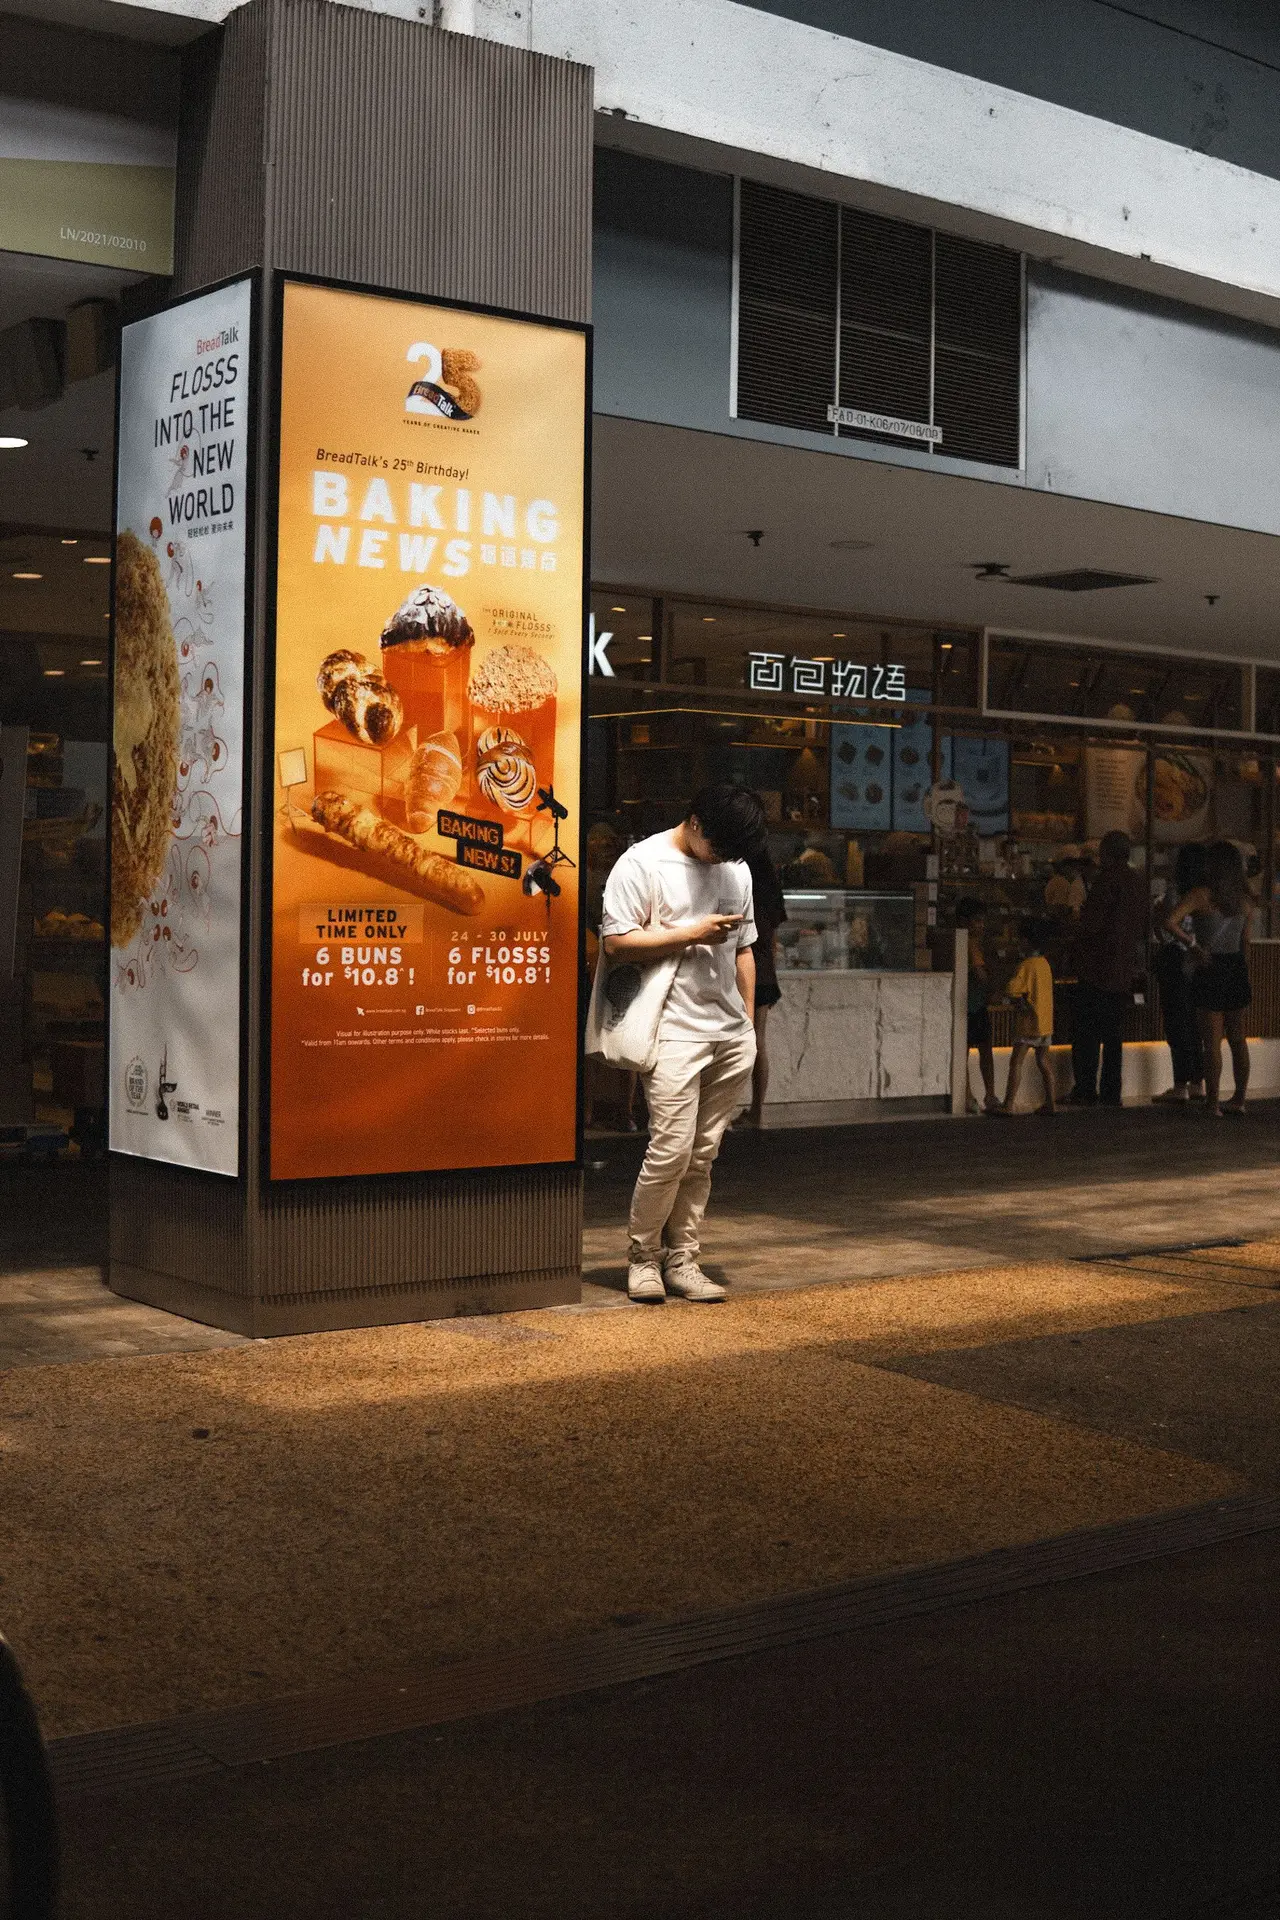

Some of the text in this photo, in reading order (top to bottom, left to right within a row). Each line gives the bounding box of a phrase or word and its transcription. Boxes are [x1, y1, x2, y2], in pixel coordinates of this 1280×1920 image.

[60, 227, 147, 251] LN/2021/02010
[197, 326, 239, 355] BreadTalk
[170, 354, 239, 403] FLOSSS
[155, 397, 236, 448] INTO THE
[402, 419, 421, 427] YEARS
[433, 423, 460, 433] CREATIVE
[193, 438, 235, 479] NEW
[316, 448, 470, 481] BreadTalk's 25th Birthday!
[169, 483, 235, 525] WORLD
[312, 469, 561, 544] BAKING
[313, 523, 473, 578] NEWS
[492, 608, 538, 621] ORIGINAL
[516, 620, 552, 632] FLOSSS
[440, 816, 499, 845] BAKING
[463, 846, 516, 874] NEWS!
[327, 909, 398, 923] LIMITED
[316, 925, 408, 938] TIME ONLY
[451, 931, 469, 942] 24
[489, 931, 507, 942] 30
[513, 931, 549, 942] JULY
[316, 946, 403, 965] 6 BUNS
[448, 946, 551, 965] 6 FLOSSS
[302, 967, 334, 986] for
[447, 967, 477, 985] for
